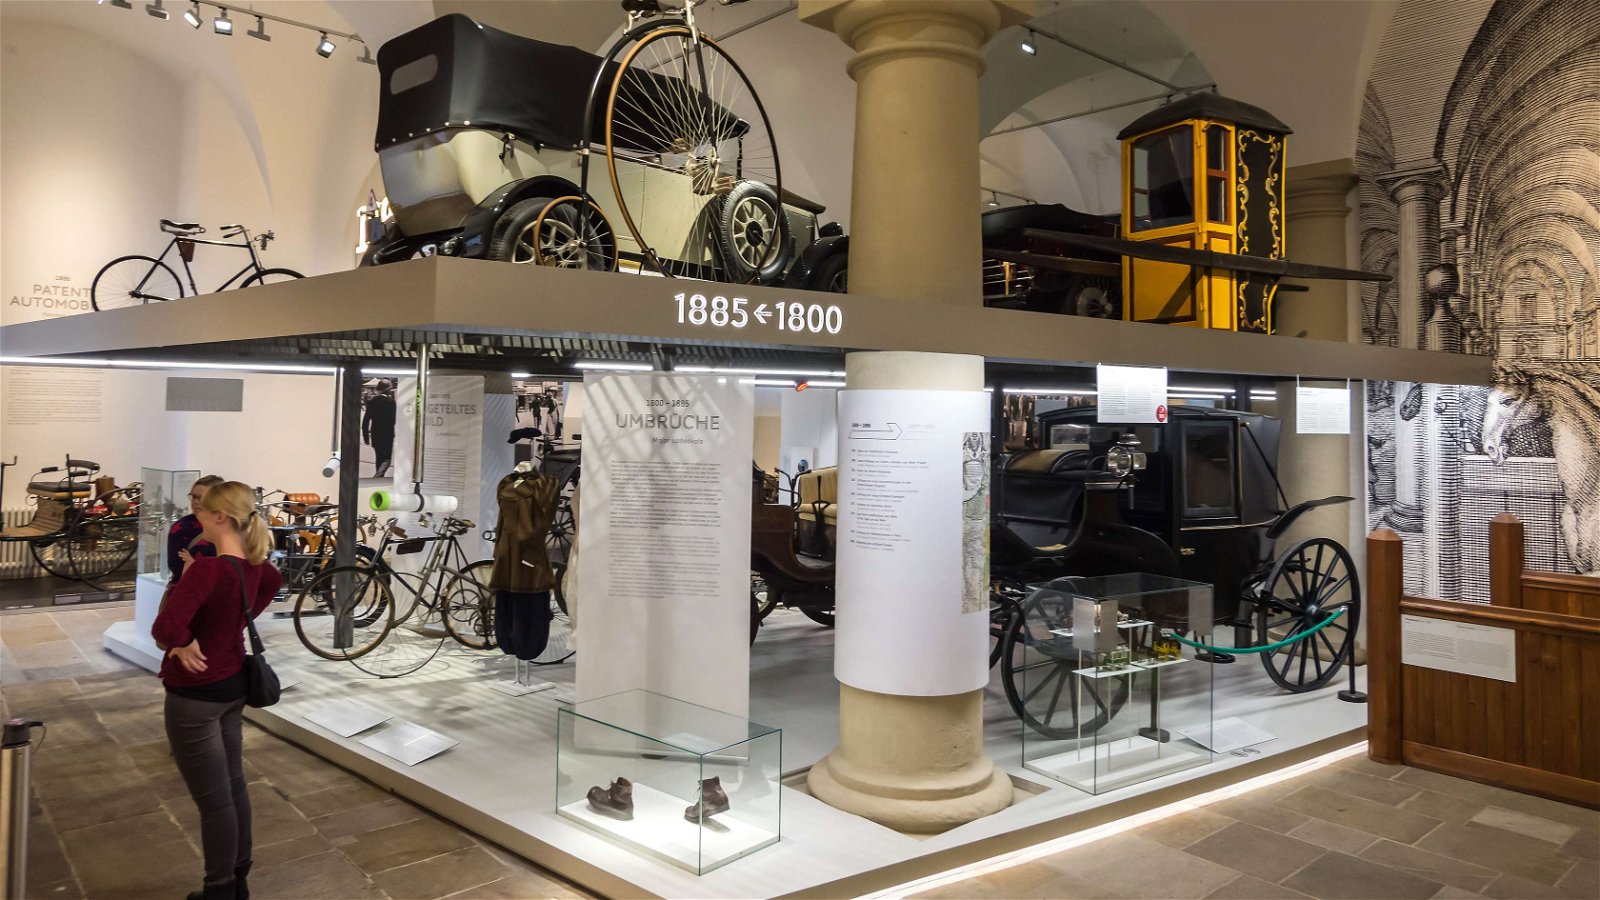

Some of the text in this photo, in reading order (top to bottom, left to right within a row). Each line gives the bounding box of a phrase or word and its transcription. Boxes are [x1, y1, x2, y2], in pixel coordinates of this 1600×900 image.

[33, 284, 92, 298] PATENT
[9, 295, 93, 310] AUTOMOB
[674, 292, 843, 334] 1885 1800
[646, 399, 664, 407] 1800
[671, 399, 690, 408] 1885
[615, 412, 720, 430] UMBRÜCHE
[652, 437, 671, 446] Major
